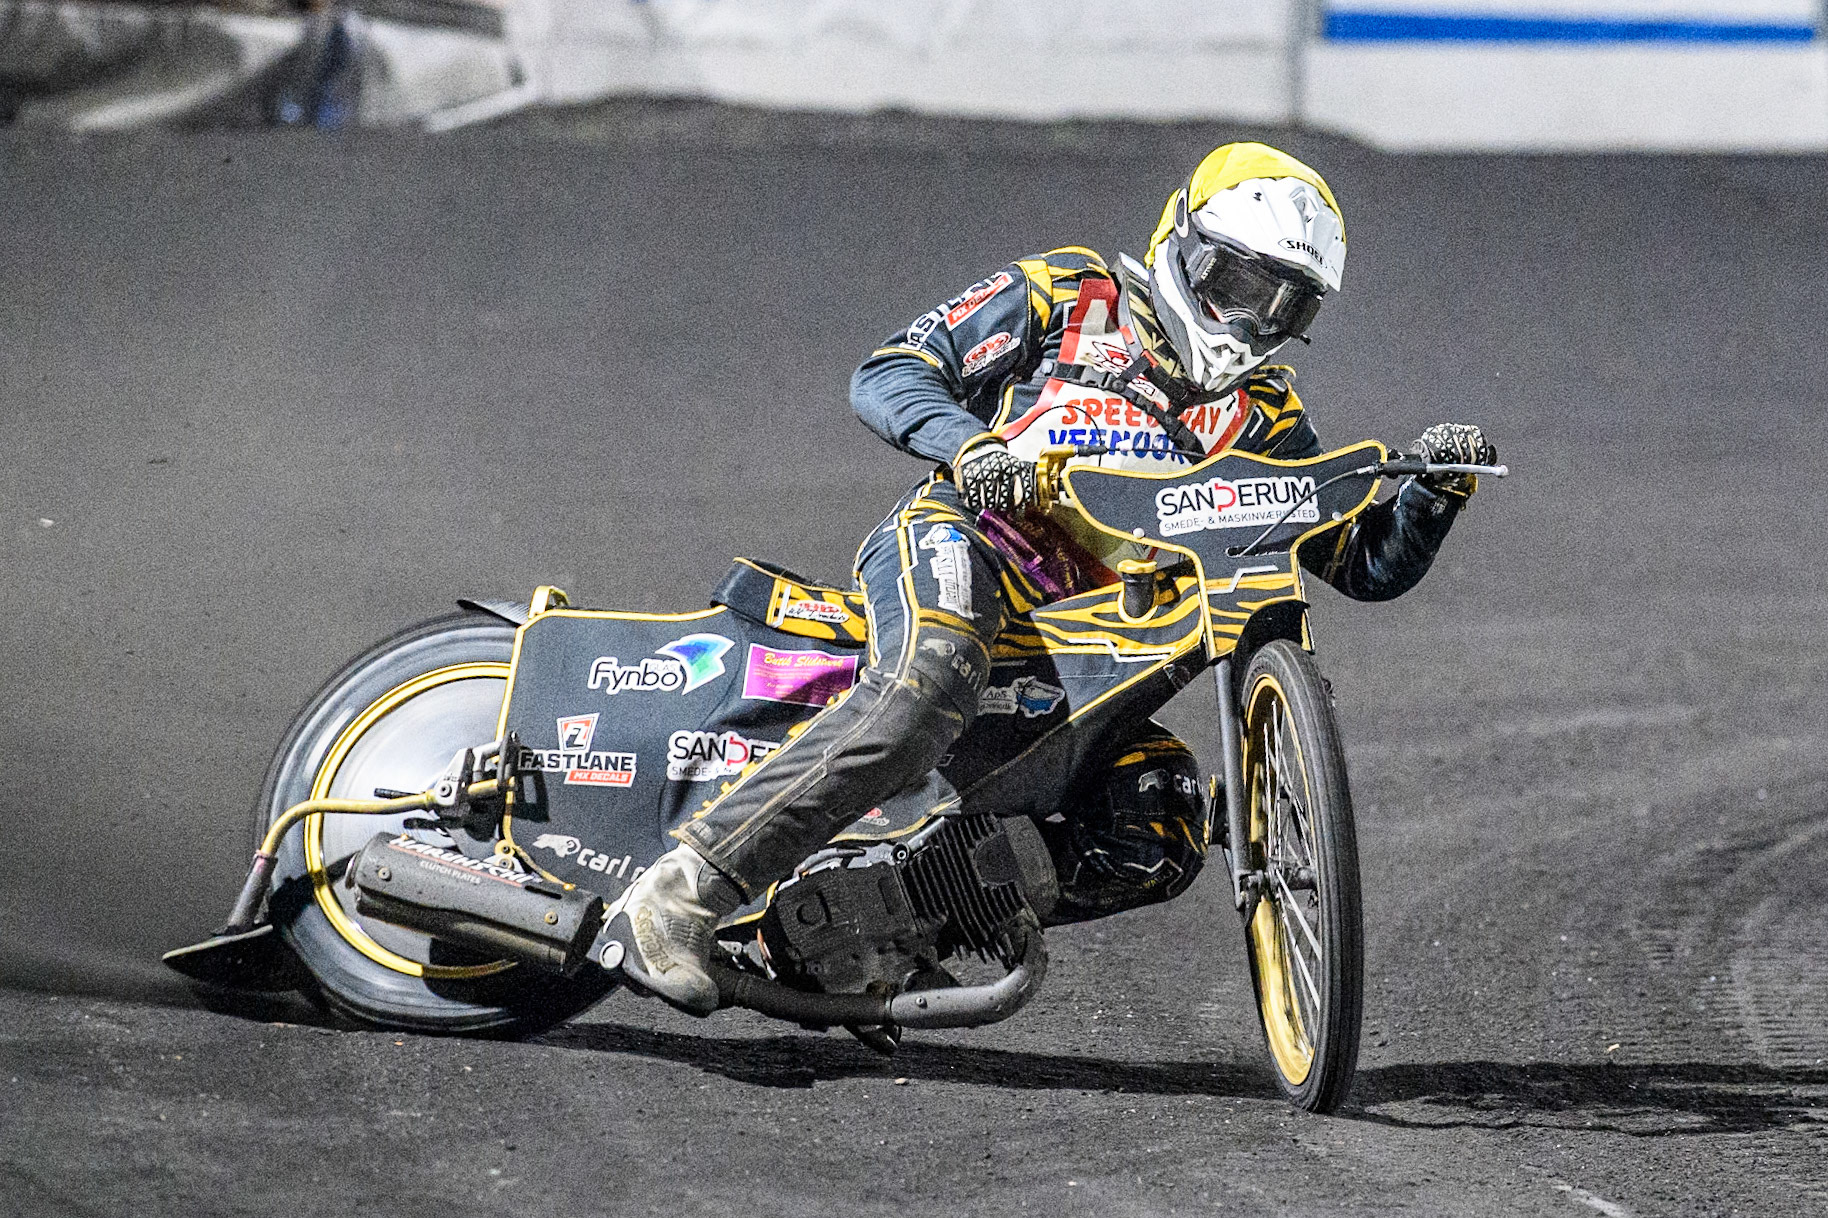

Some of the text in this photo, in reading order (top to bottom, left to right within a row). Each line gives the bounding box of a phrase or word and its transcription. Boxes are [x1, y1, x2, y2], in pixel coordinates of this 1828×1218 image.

[1286, 240, 1323, 265] SHOEI
[1161, 481, 1313, 516] SANDERUM
[1208, 516, 1216, 525] &
[521, 752, 633, 771] FASTLANE
[673, 736, 776, 766] SANDE
[574, 772, 628, 782] MX DECALS
[420, 860, 481, 884] CLUTCH PLATES
[577, 848, 632, 878] carl
